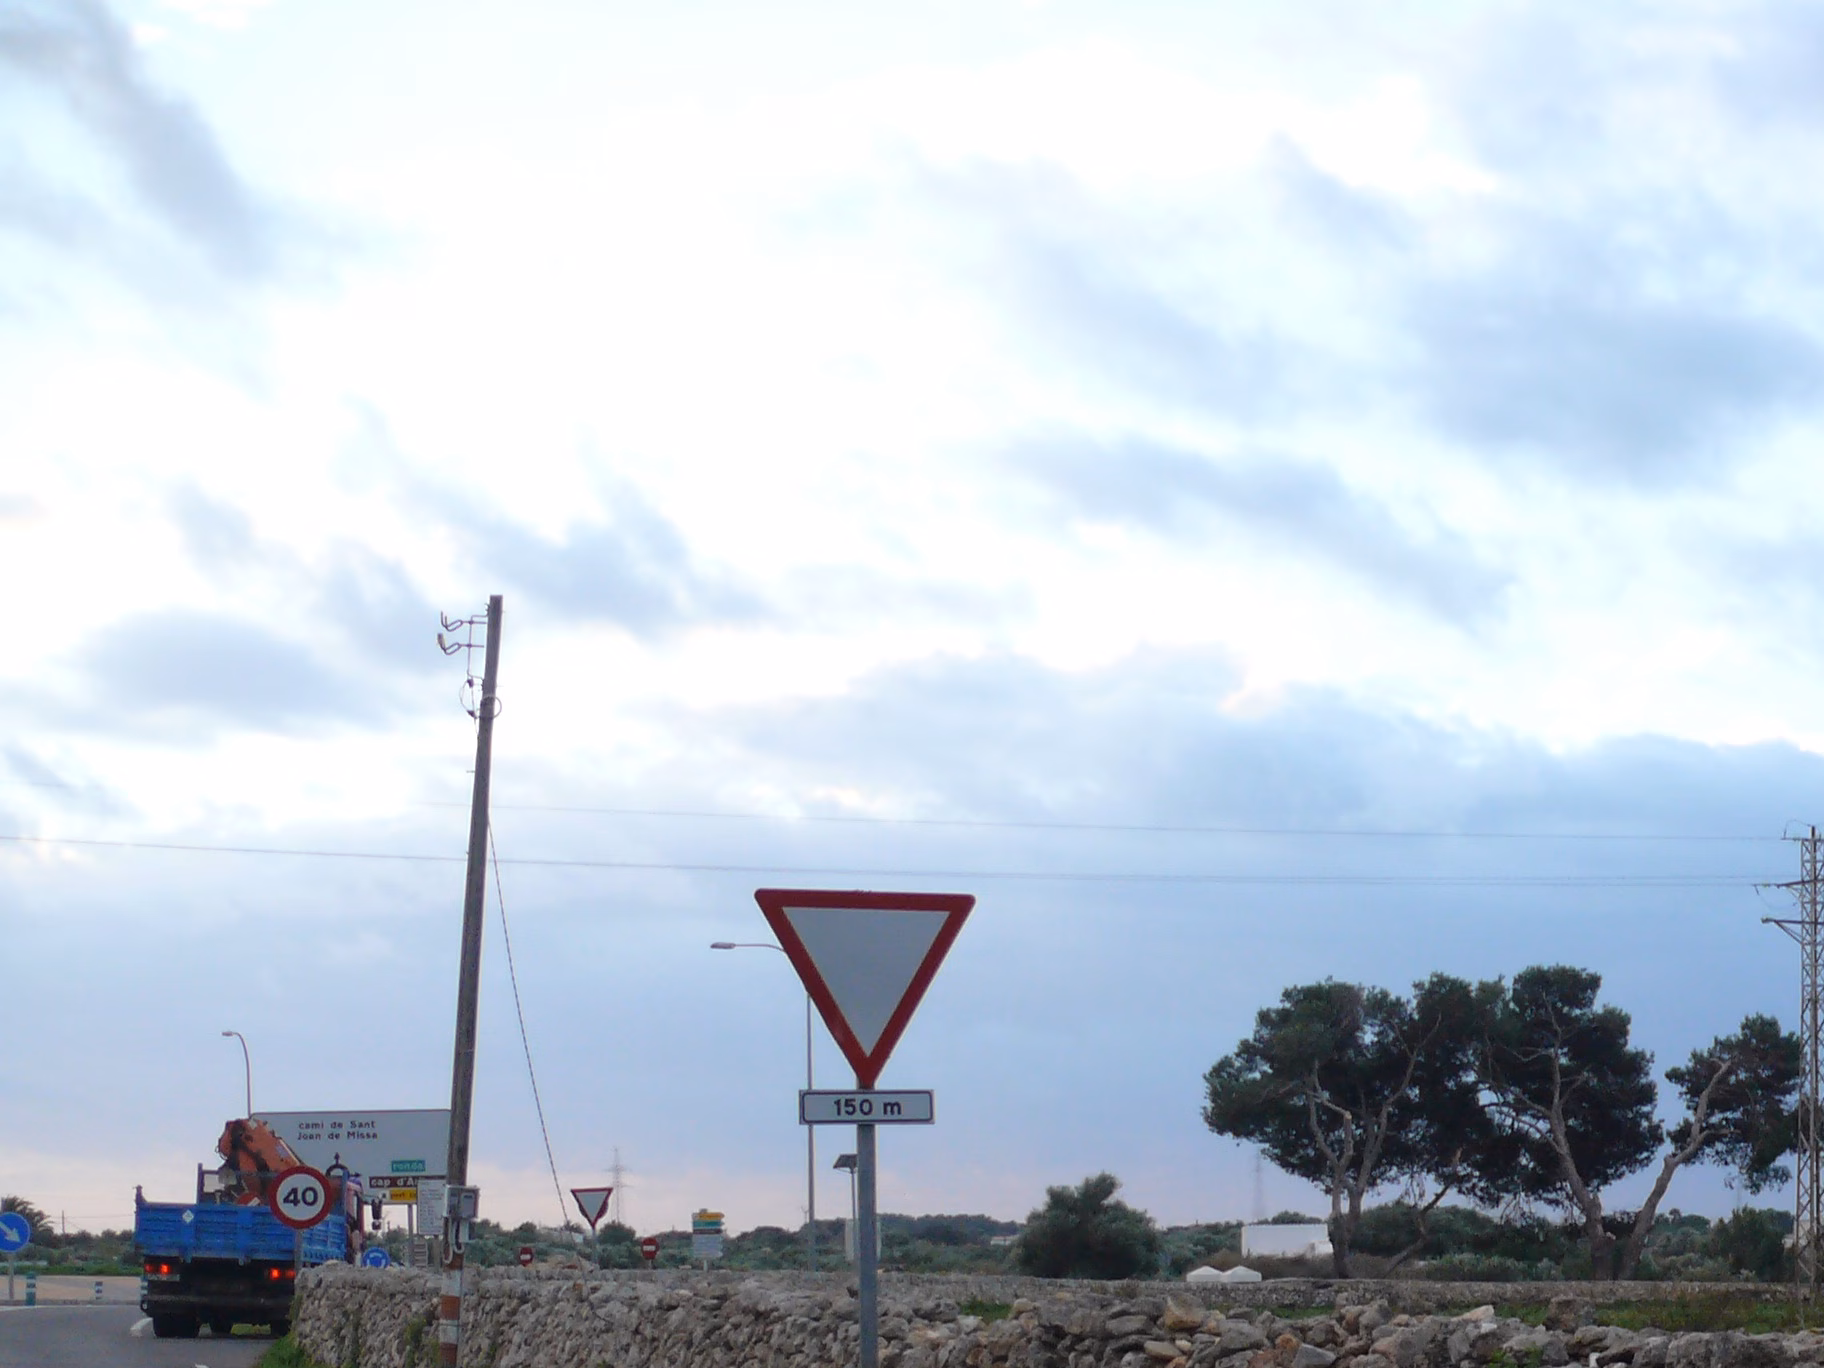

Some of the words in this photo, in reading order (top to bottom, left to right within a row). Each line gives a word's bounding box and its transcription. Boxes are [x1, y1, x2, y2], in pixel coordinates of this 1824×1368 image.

[834, 1098, 873, 1116] 150
[883, 1101, 902, 1116] m
[330, 1121, 343, 1129] de
[350, 1120, 376, 1129] Sant
[298, 1132, 321, 1141] Joan
[327, 1132, 340, 1140] de
[347, 1131, 378, 1140] Missa
[371, 1178, 391, 1188] cap
[283, 1187, 318, 1207] 40
